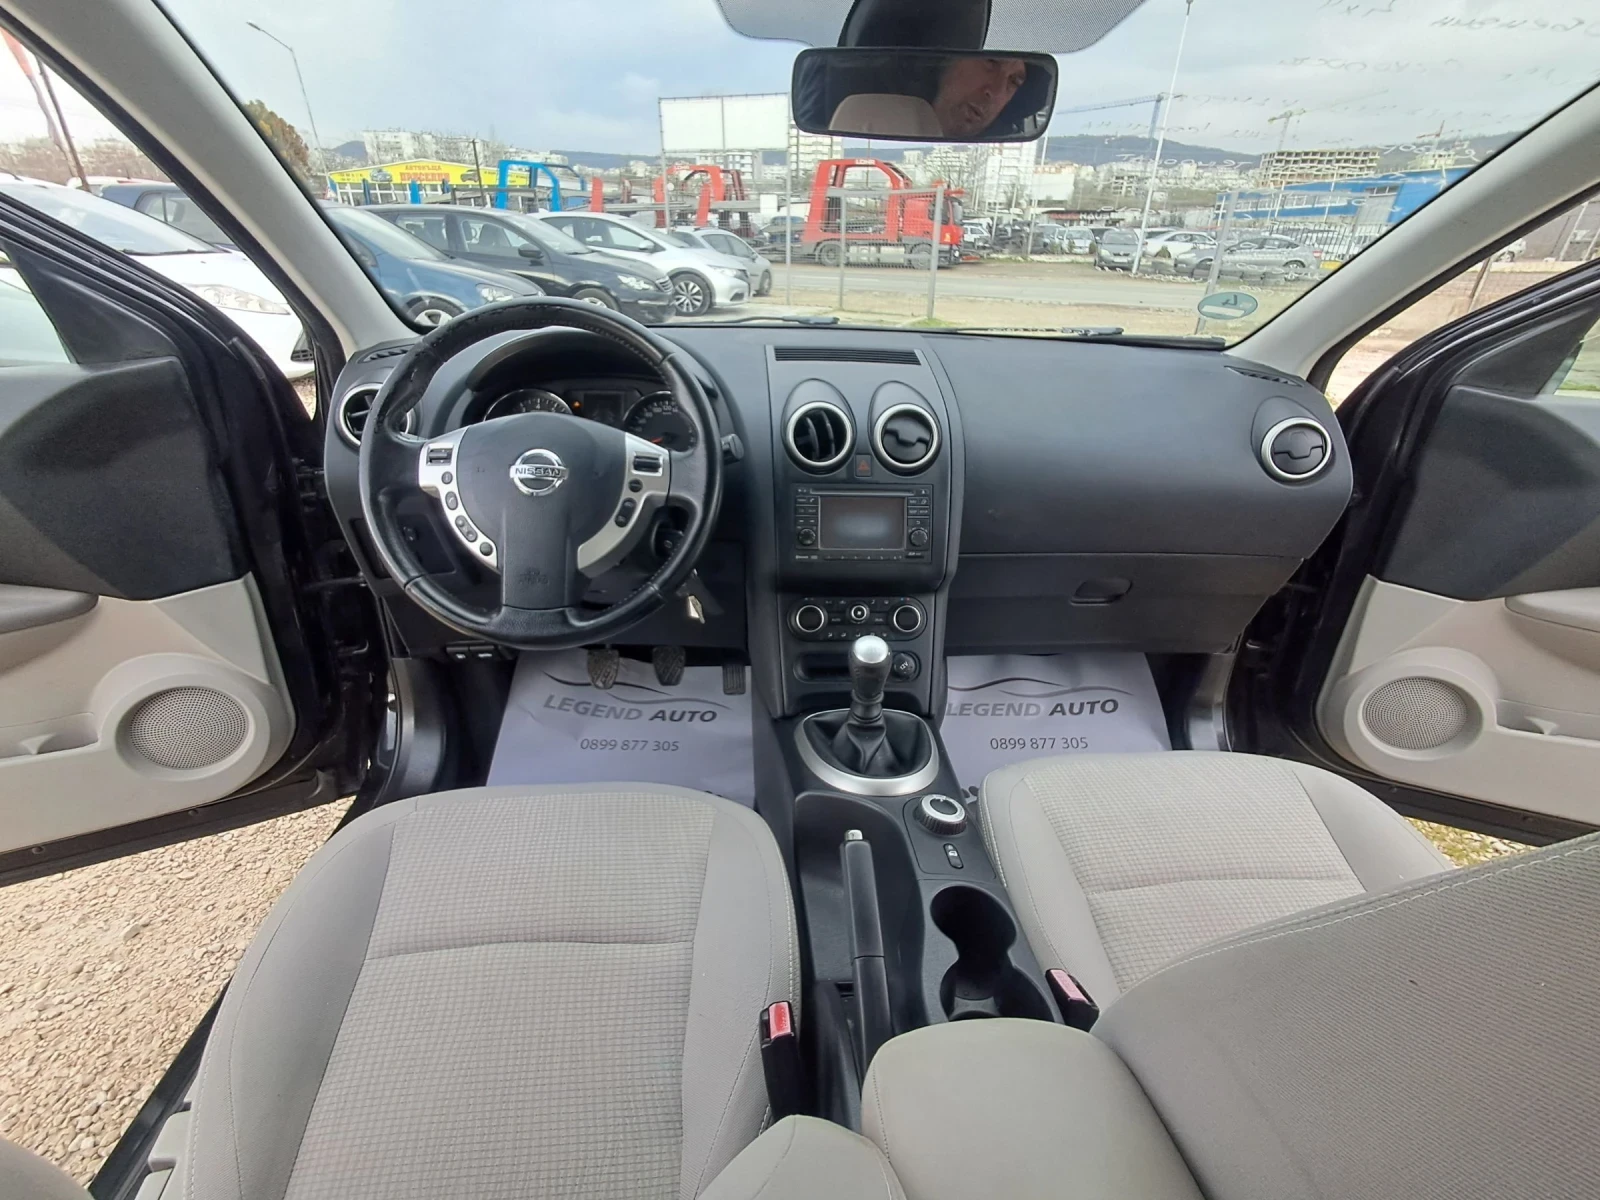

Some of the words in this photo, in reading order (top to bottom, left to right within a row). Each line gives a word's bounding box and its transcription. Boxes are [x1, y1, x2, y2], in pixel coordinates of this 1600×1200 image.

[514, 467, 562, 477] NISSAN
[543, 694, 643, 721] LEGEND
[648, 708, 717, 723] AUTO
[945, 702, 1041, 717] LEGEND
[1049, 699, 1119, 716] AUTO
[580, 738, 617, 751] 0899
[620, 739, 648, 751] 877
[652, 740, 679, 752] 305
[990, 737, 1025, 750] 0899
[1030, 737, 1056, 749] 877
[1061, 736, 1088, 749] 305
